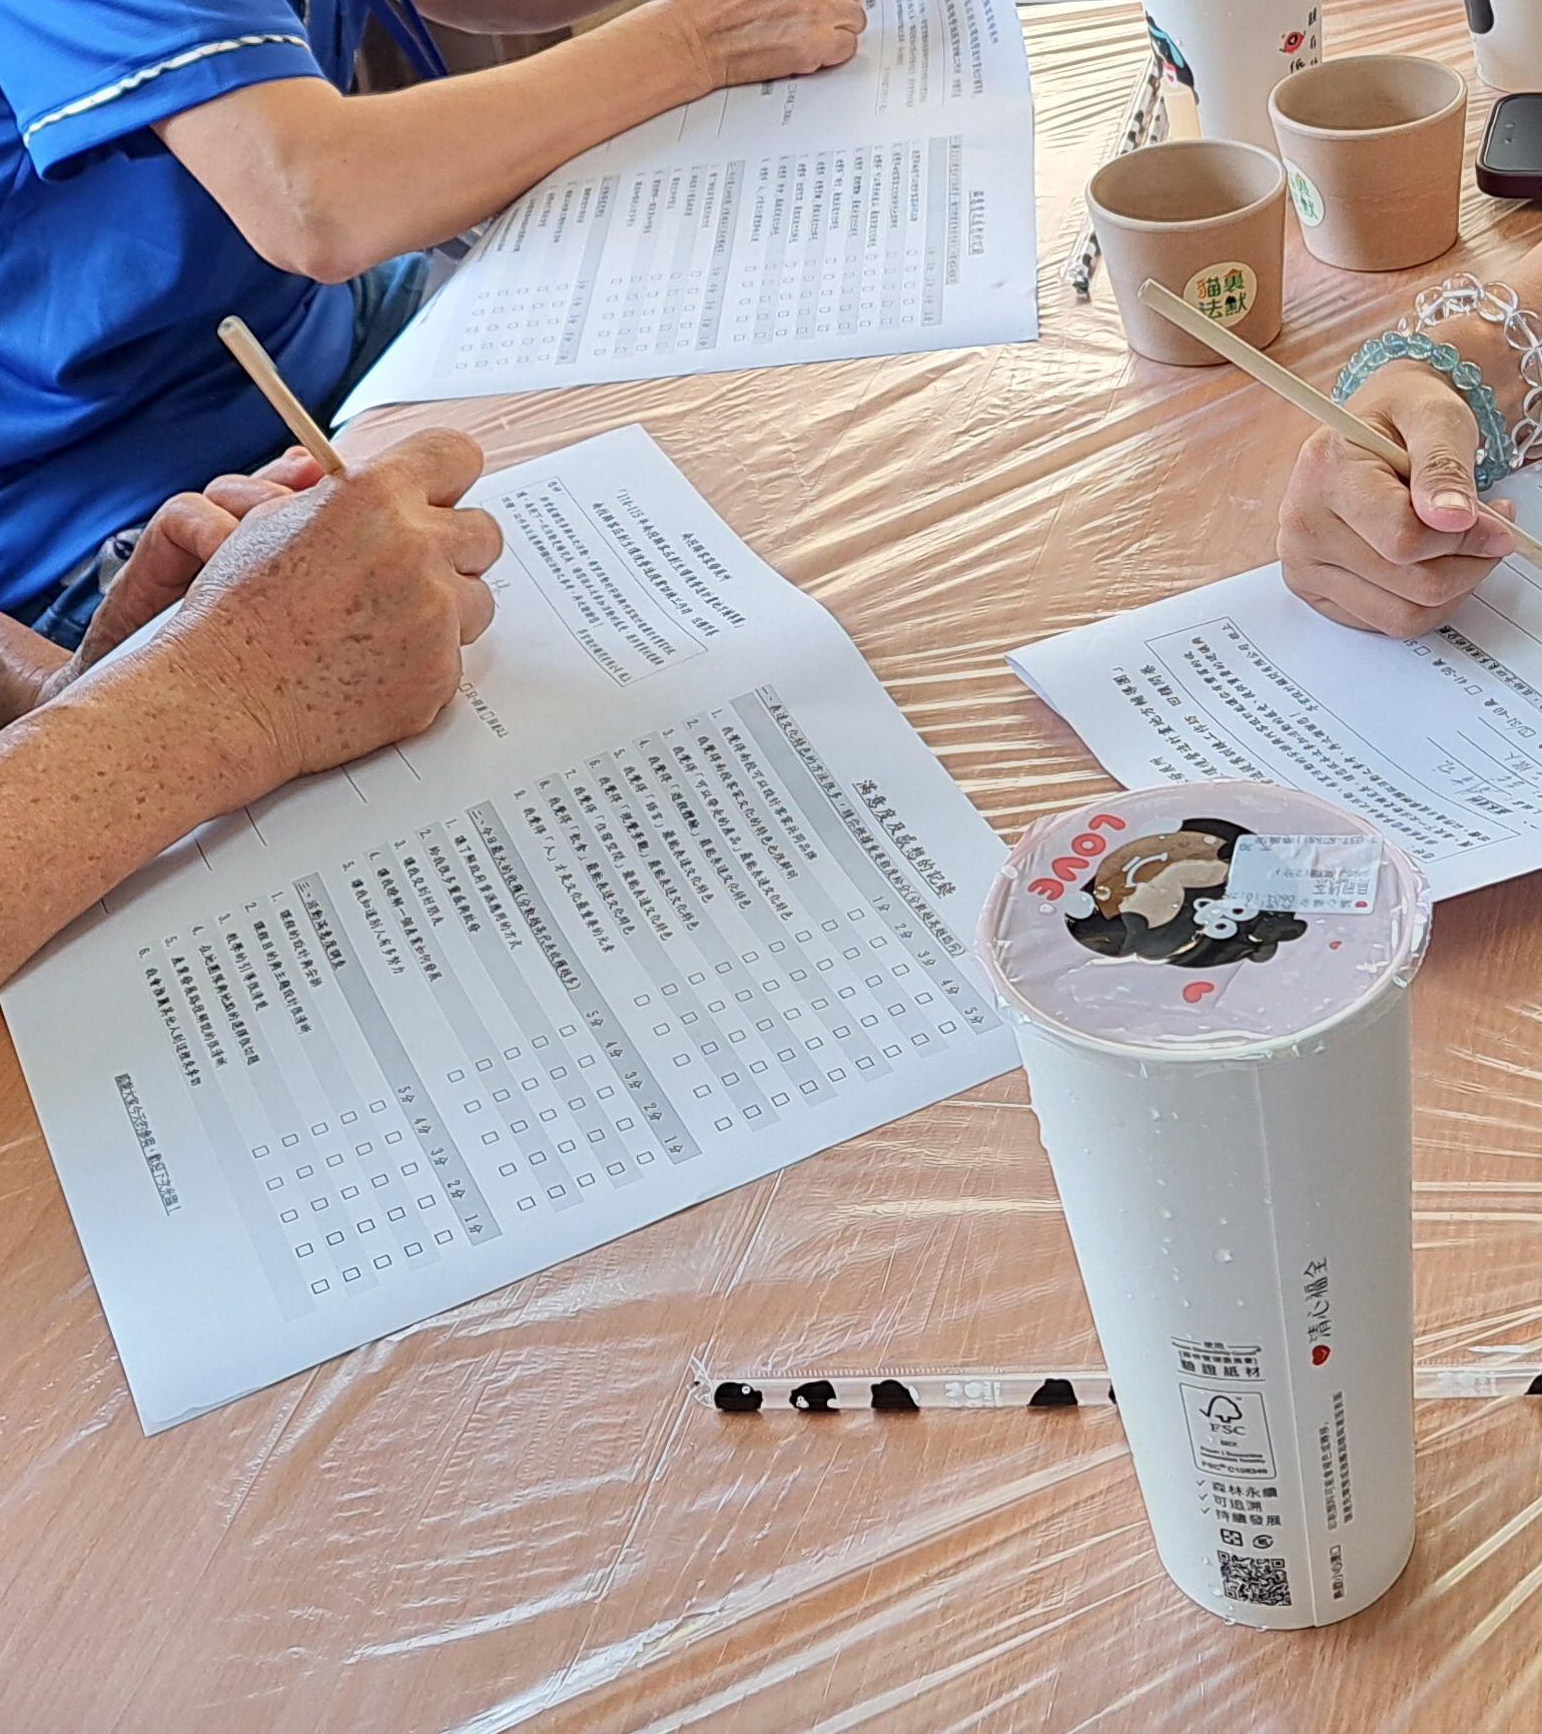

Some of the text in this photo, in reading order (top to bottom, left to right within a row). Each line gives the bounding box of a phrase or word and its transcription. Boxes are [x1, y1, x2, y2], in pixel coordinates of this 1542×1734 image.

[1113, 667, 1223, 775] 環境營造計畫地方輔導團」
[1150, 757, 1189, 787] 發展所
[1027, 813, 1127, 902] LOVE
[873, 896, 890, 911] 1分
[895, 923, 912, 938] 2分
[918, 951, 936, 966] 3分
[941, 980, 959, 994] 4分
[586, 1010, 603, 1026] 5分
[965, 1007, 984, 1023] 5分
[606, 1042, 623, 1057] 4分
[625, 1072, 643, 1088] 3分
[398, 1086, 415, 1103] 5分
[644, 1103, 662, 1120] 2分
[415, 1119, 431, 1134] 4分
[665, 1136, 683, 1153] 1分
[431, 1148, 448, 1165] 3分
[447, 1180, 465, 1198] 2分
[465, 1215, 483, 1233] 1分
[1302, 1256, 1334, 1344] 清心福全
[1210, 1422, 1256, 1436] FSC
[1215, 1509, 1282, 1527] 持續發展
